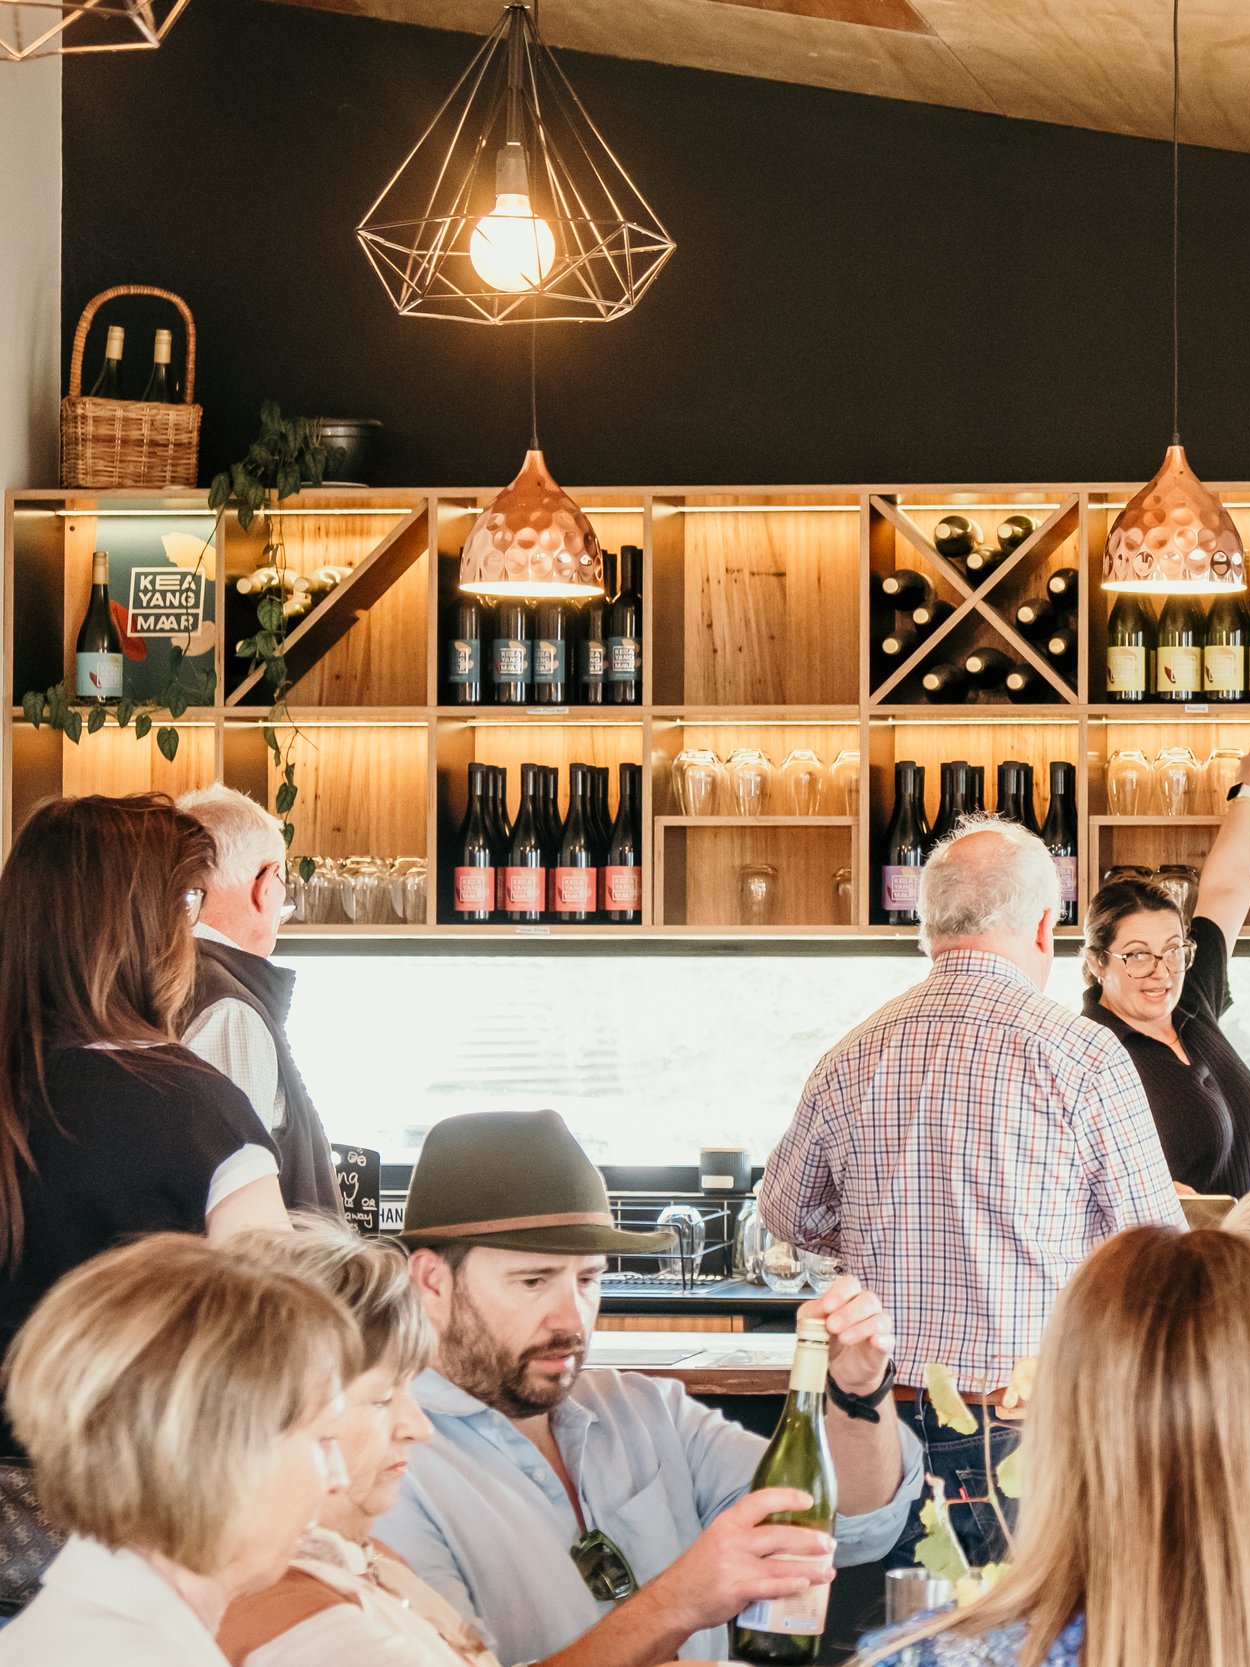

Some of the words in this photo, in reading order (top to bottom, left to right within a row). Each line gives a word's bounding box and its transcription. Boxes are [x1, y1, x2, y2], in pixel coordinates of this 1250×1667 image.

[140, 575, 196, 590] KEA
[139, 592, 195, 607] YANG
[137, 615, 194, 630] MAAR
[361, 1198, 376, 1207] OR
